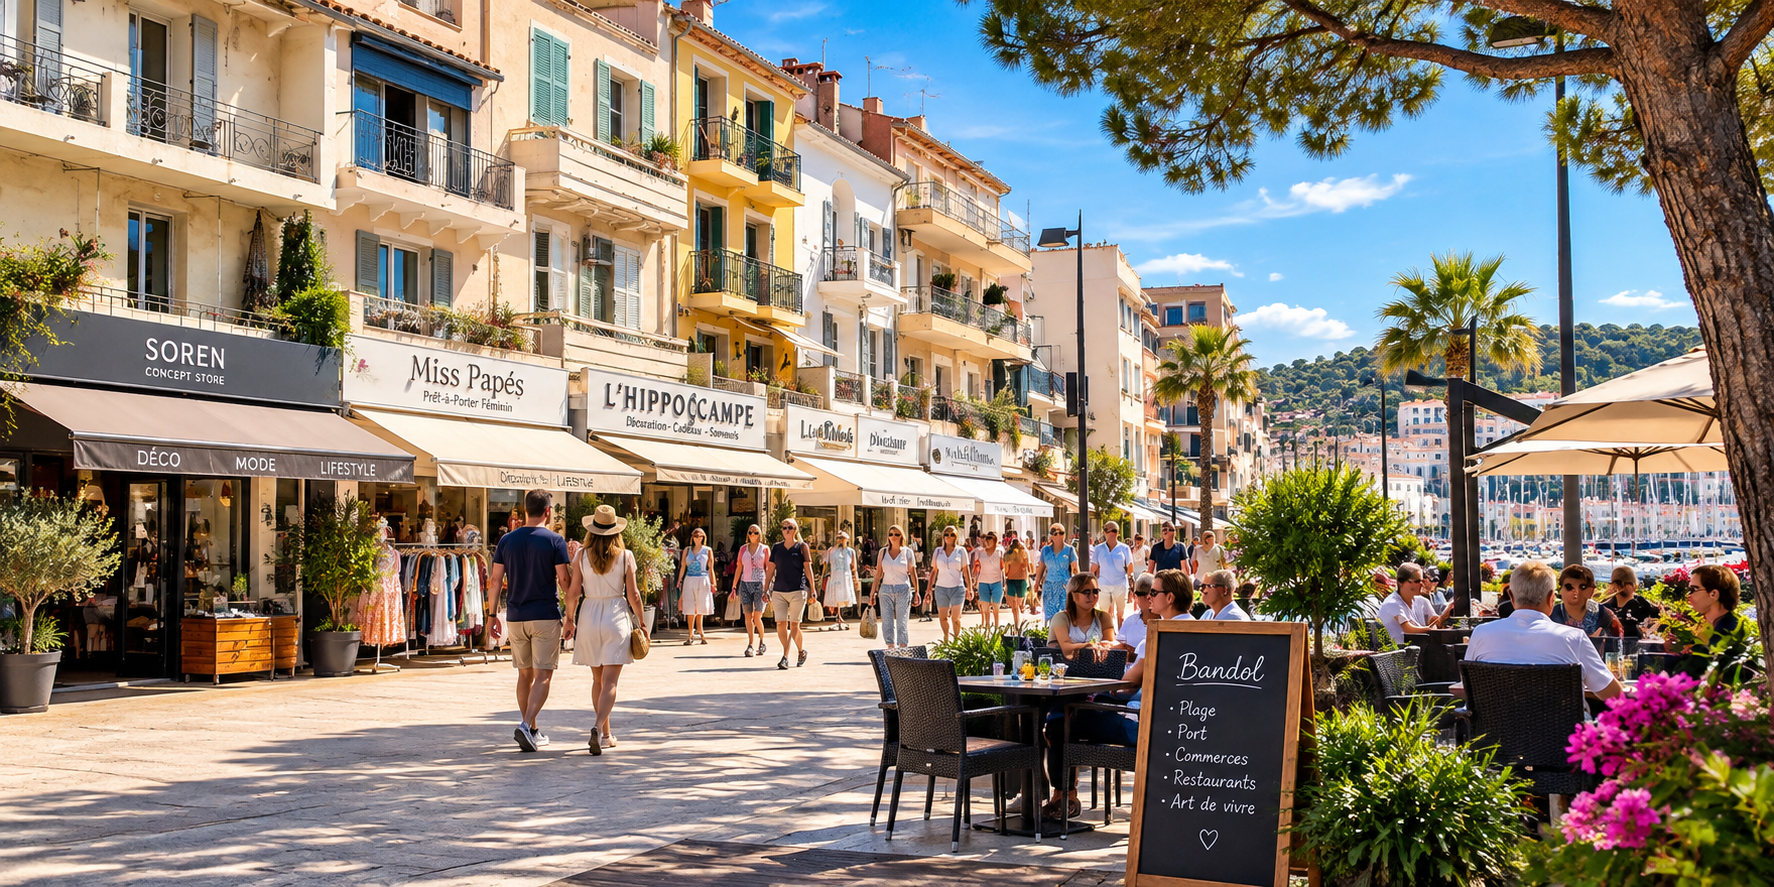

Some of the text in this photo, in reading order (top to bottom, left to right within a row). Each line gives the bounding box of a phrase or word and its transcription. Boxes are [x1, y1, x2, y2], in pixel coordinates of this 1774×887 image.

[145, 337, 225, 370] SOREN
[145, 366, 225, 385] CONCEPT STORE
[411, 355, 524, 399] Miss Papés
[137, 446, 376, 477] DÉCO MODE LIFESTYLE
[1176, 652, 1265, 681] Bandol
[1179, 700, 1216, 722] Plage
[1177, 723, 1208, 741] Port
[1175, 746, 1249, 766] Commerces
[1173, 769, 1256, 790] Restaurants
[1170, 793, 1255, 815] Art de vivre
